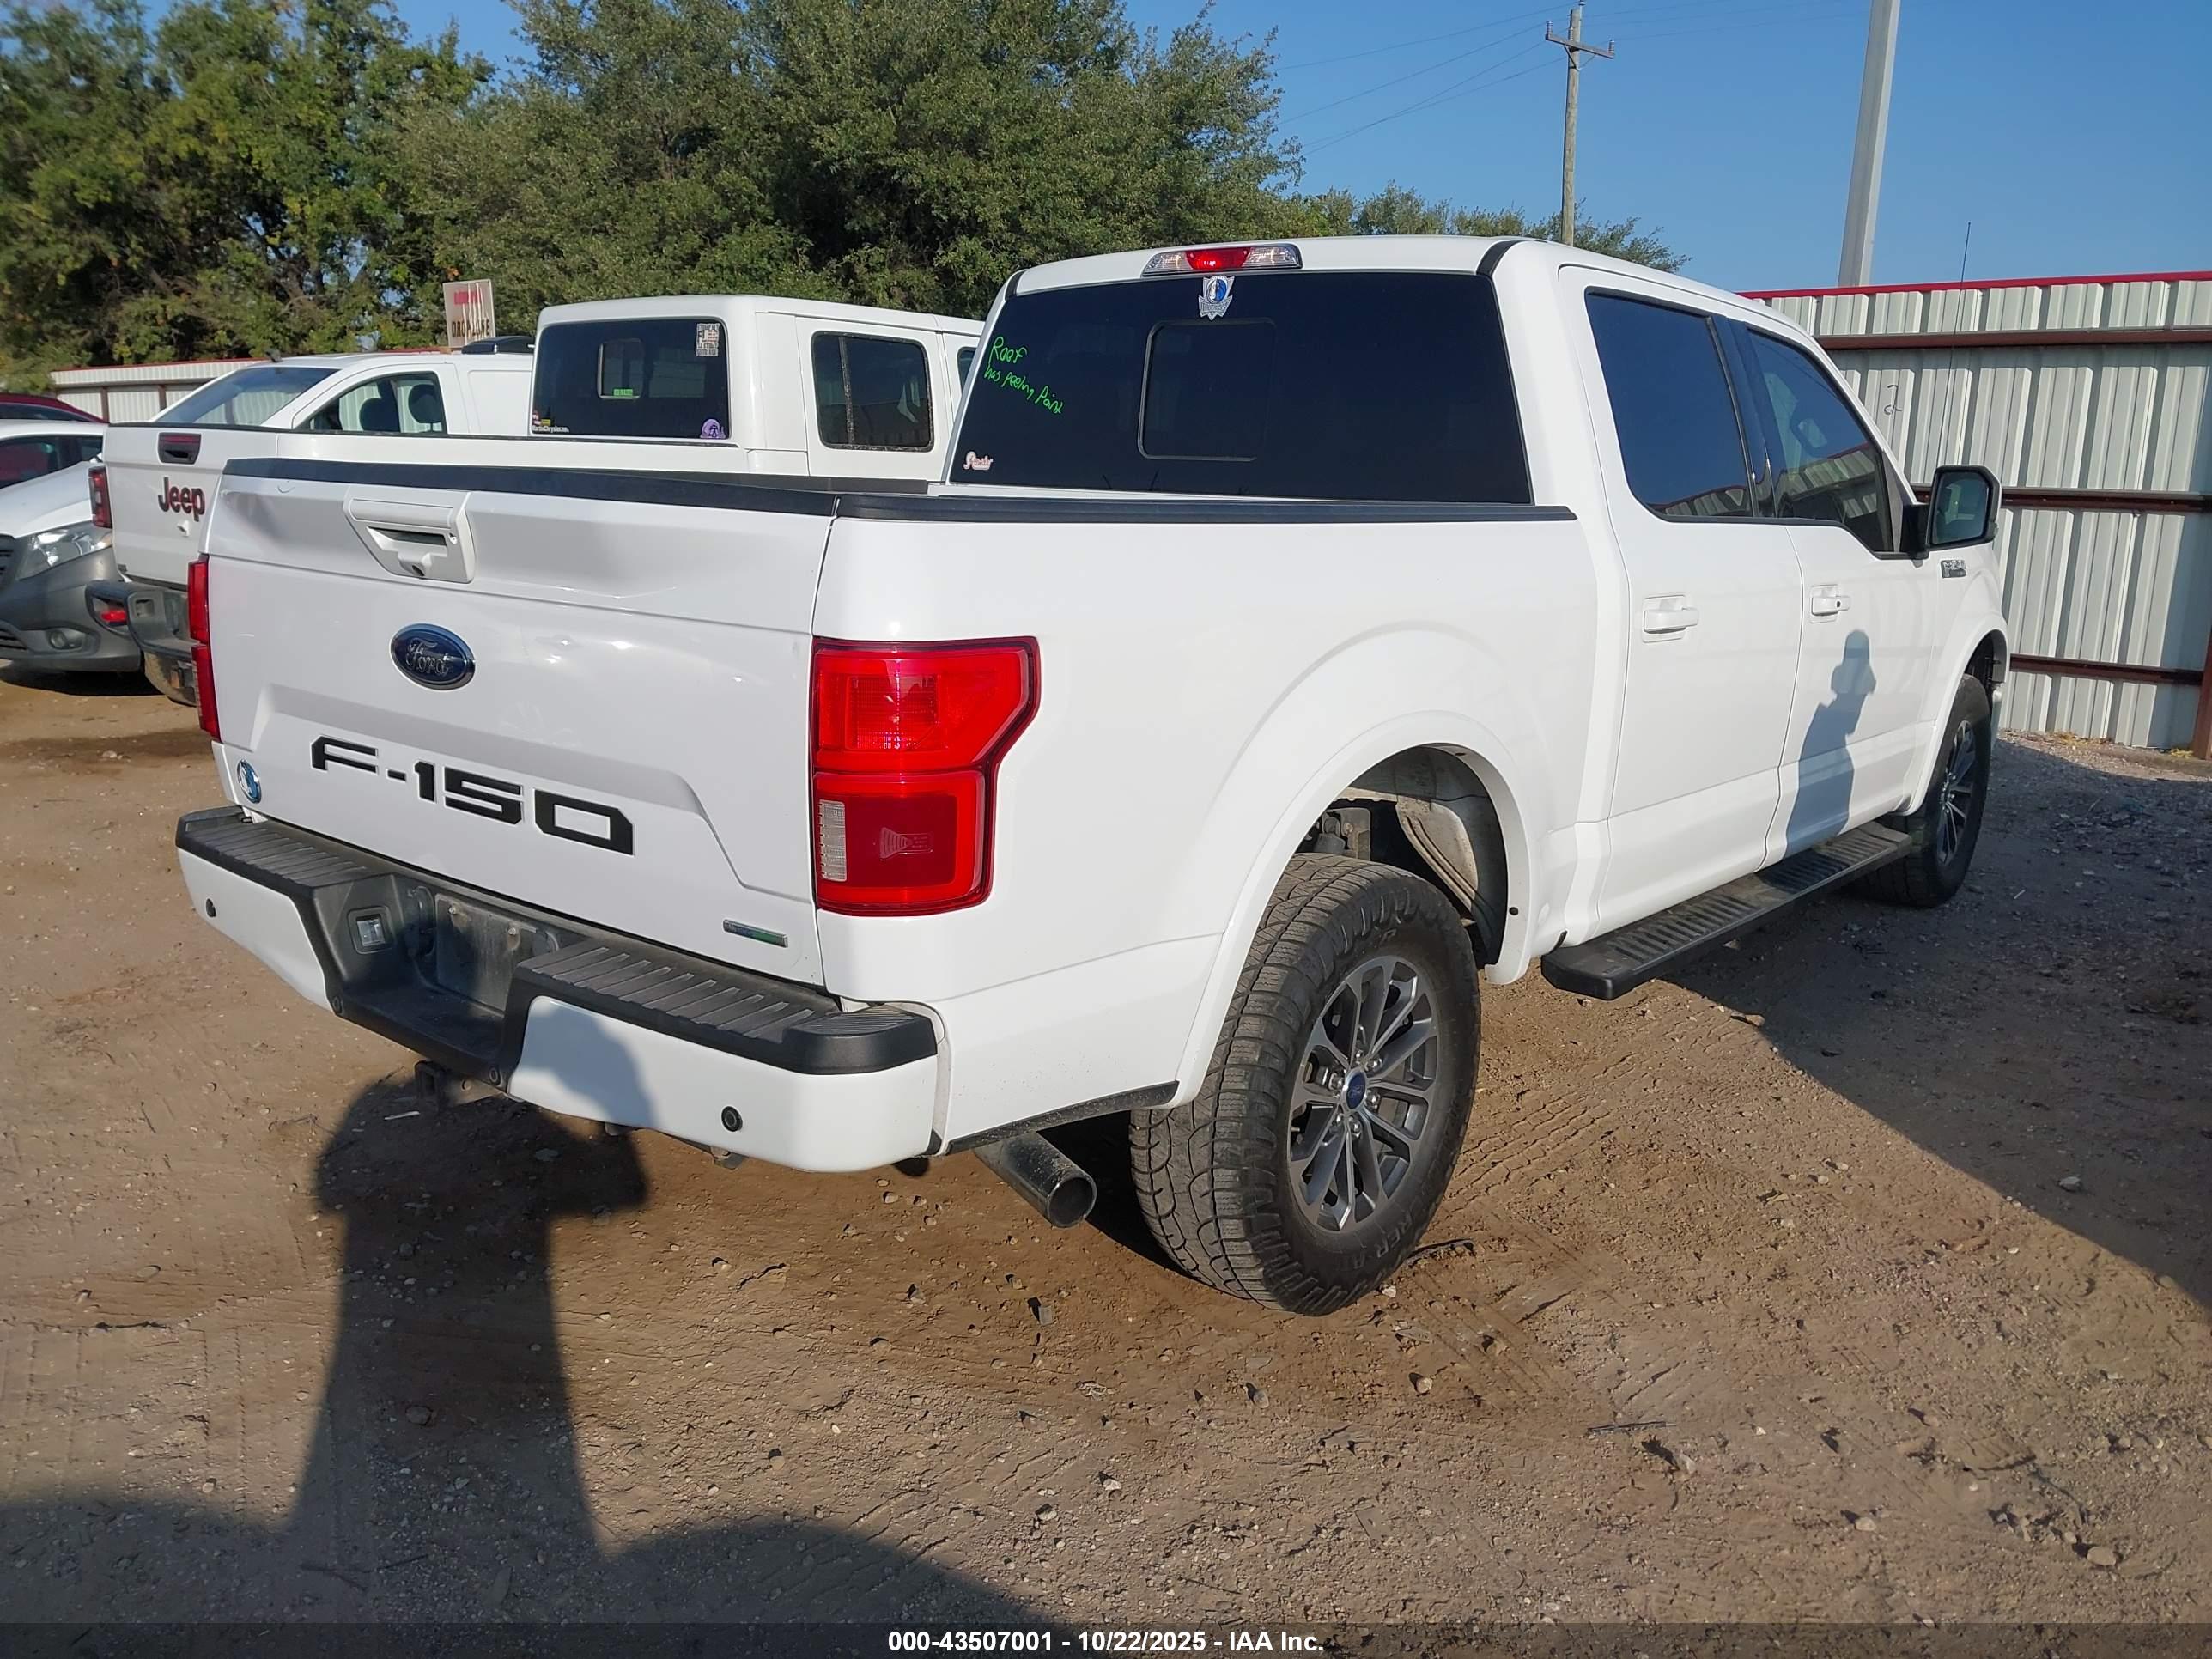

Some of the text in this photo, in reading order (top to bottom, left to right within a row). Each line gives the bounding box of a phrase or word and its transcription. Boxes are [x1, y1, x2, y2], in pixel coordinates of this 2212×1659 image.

[157, 476, 206, 523] Jeep
[405, 637, 453, 677] Ford
[310, 735, 635, 856] F-150
